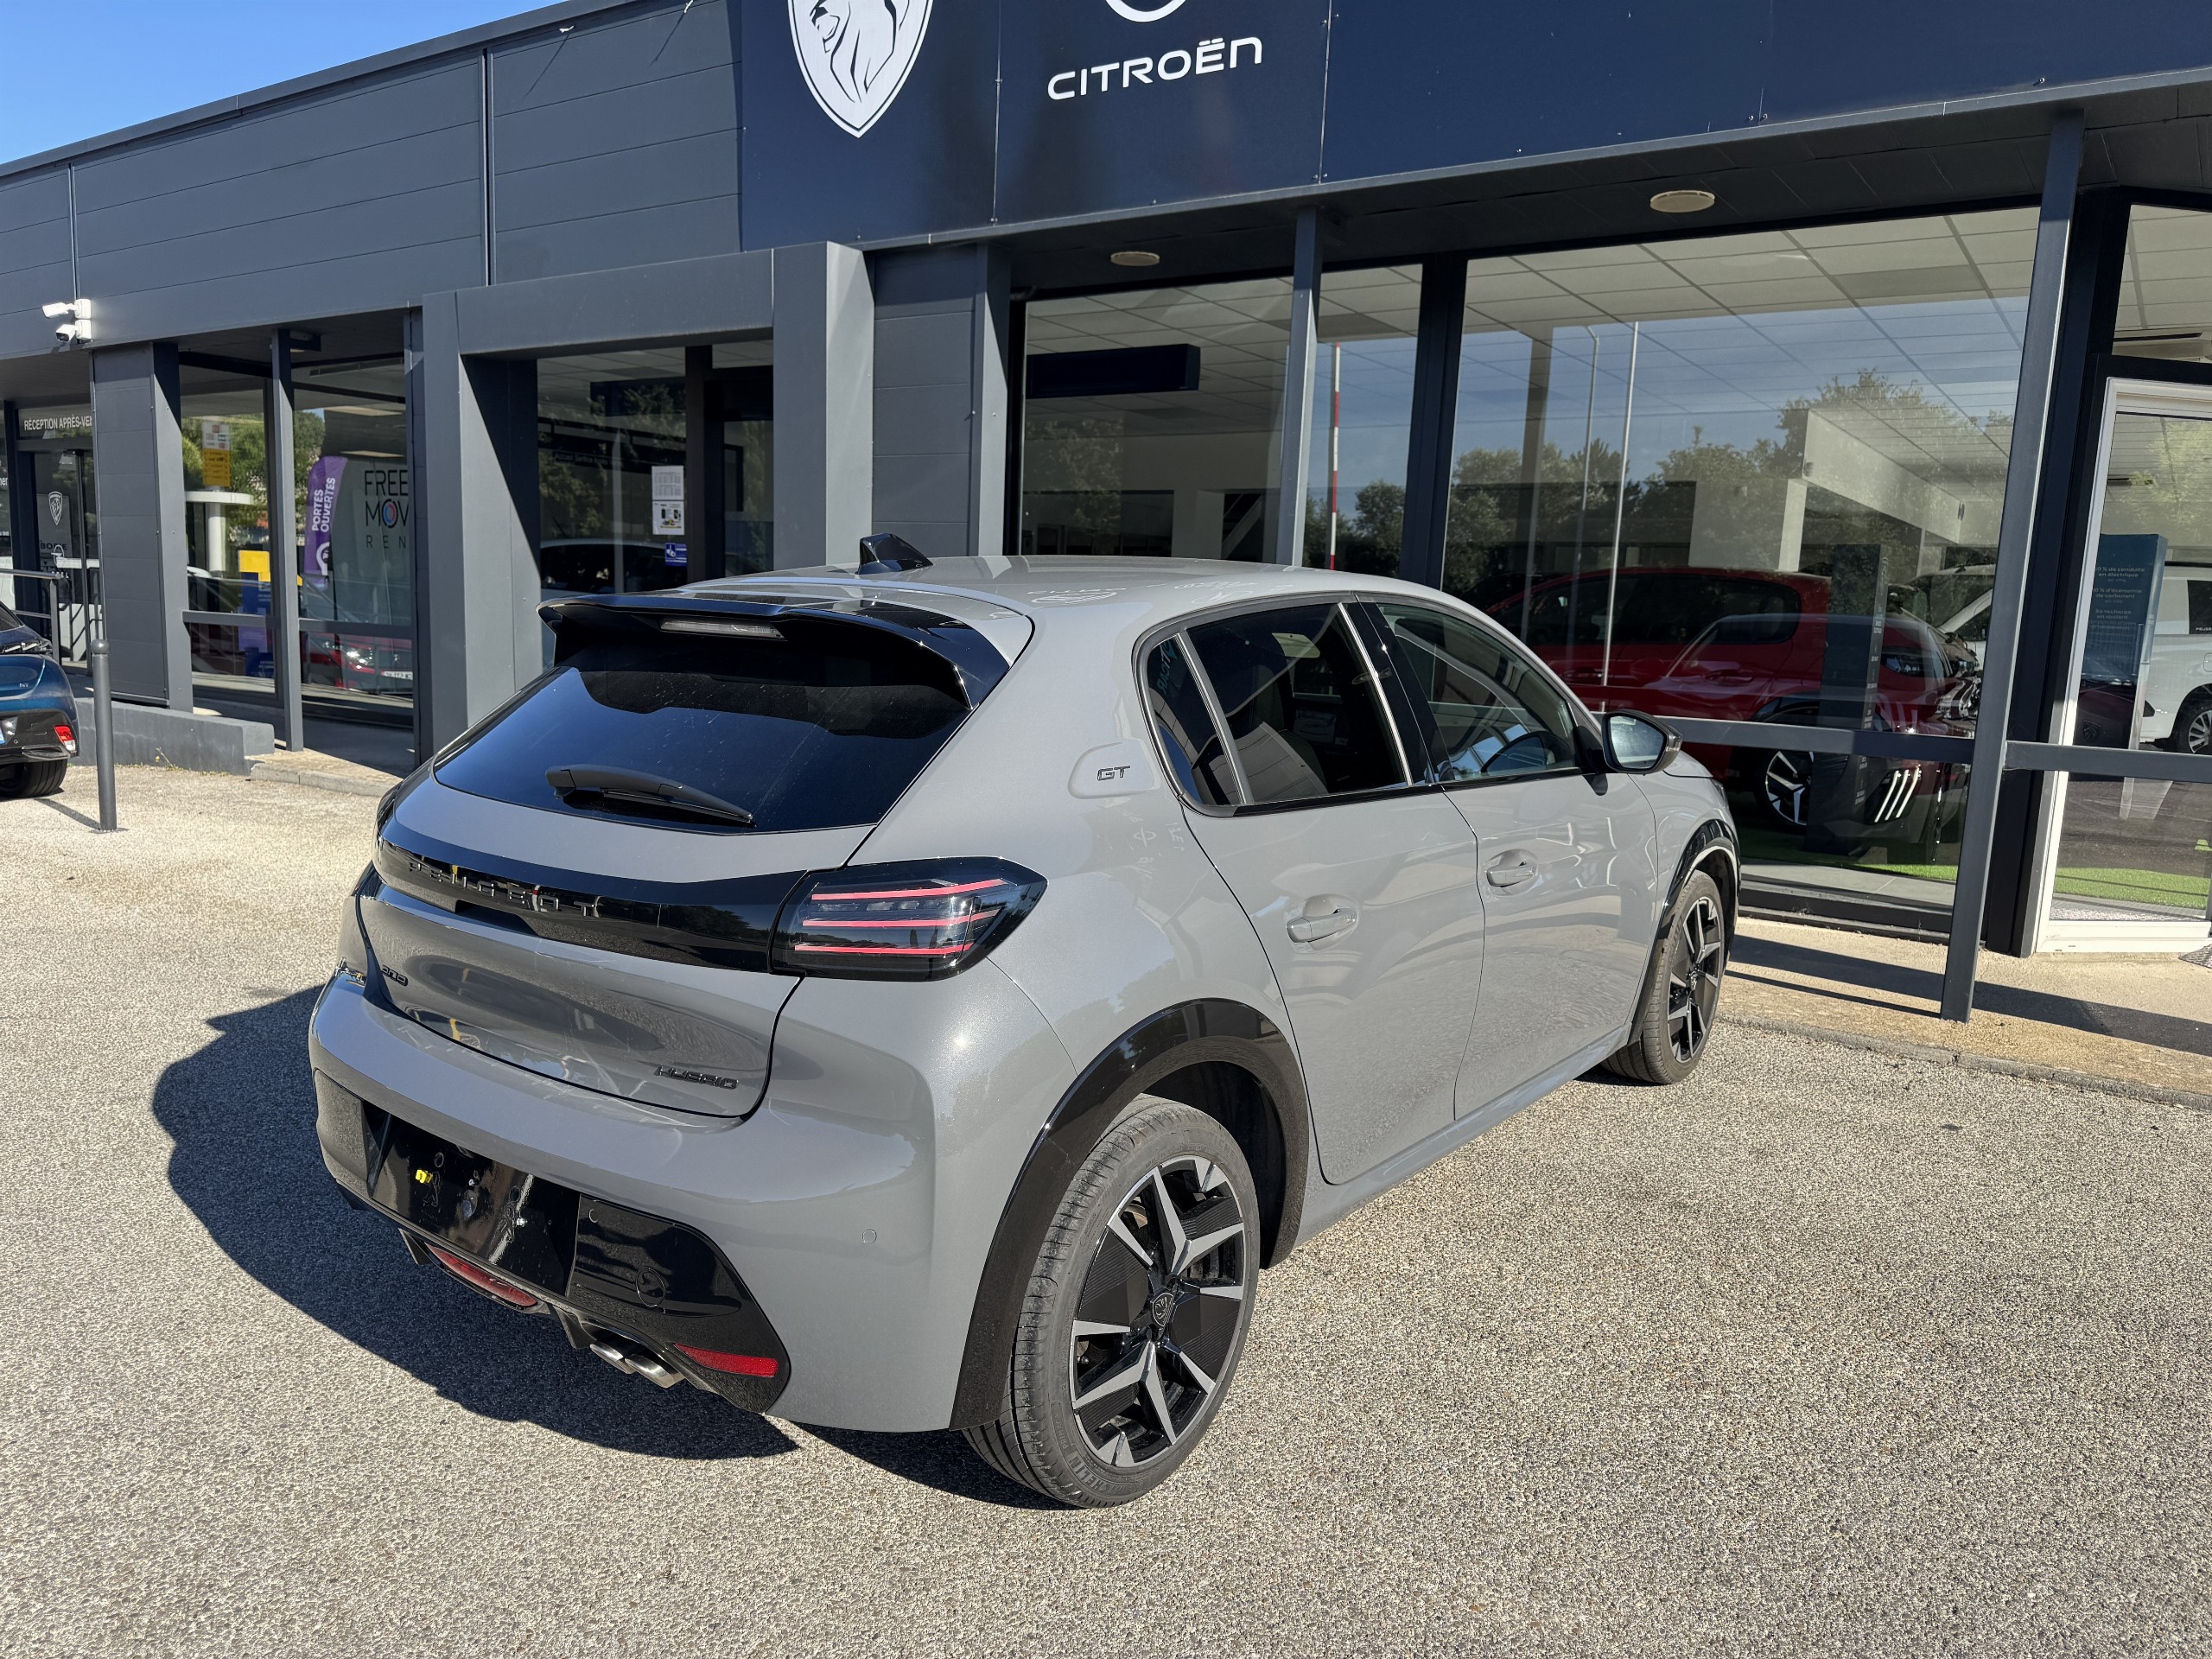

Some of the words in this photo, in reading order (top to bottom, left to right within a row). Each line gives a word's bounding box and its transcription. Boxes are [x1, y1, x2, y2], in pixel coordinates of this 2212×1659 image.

[1047, 36, 1262, 100] CITROËN
[24, 417, 58, 431] RÉCEPTION
[364, 469, 409, 497] FREE
[311, 489, 324, 531] PORTES
[320, 477, 336, 532] OUVERTES
[1097, 766, 1130, 781] GT
[409, 862, 595, 918] PEUGEOT
[654, 1065, 739, 1090] HYBRID
